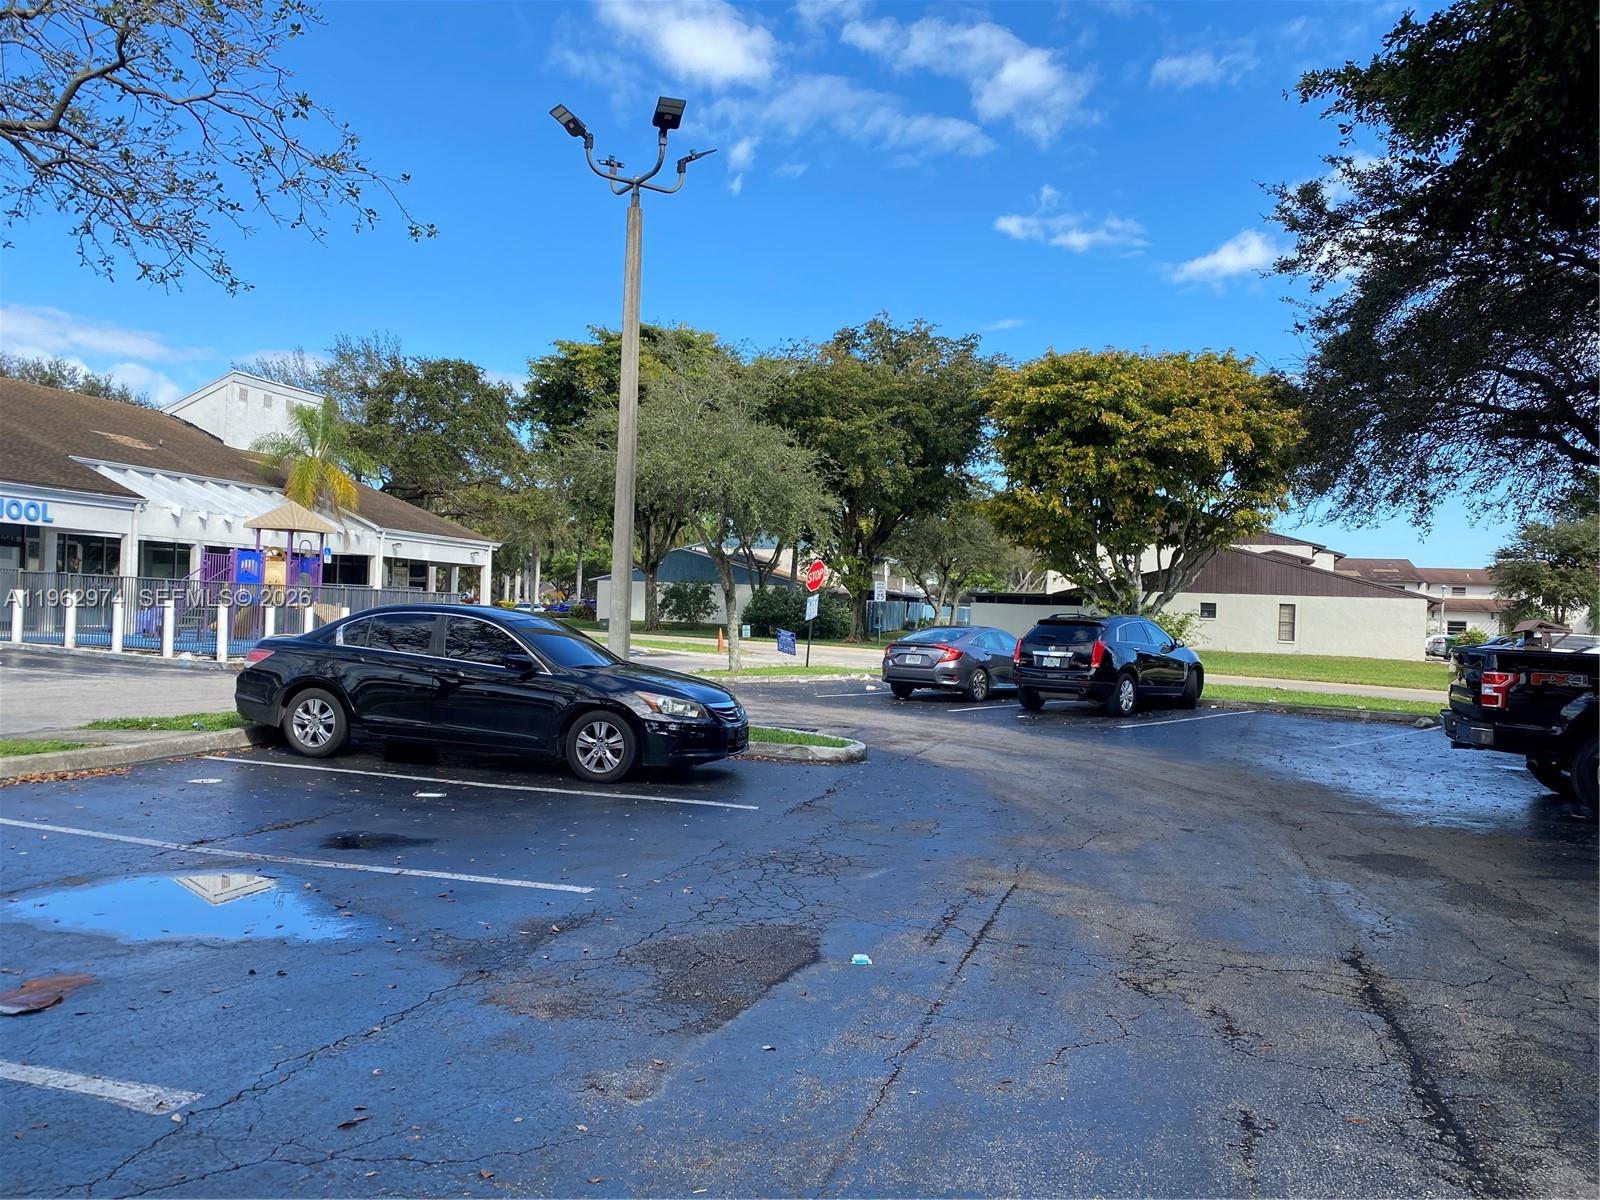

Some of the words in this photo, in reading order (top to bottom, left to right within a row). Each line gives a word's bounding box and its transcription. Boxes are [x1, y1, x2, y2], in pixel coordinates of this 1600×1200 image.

[0, 498, 54, 523] OOL
[808, 568, 824, 584] STOP
[876, 592, 885, 600] 25
[1531, 672, 1588, 686] FX4
